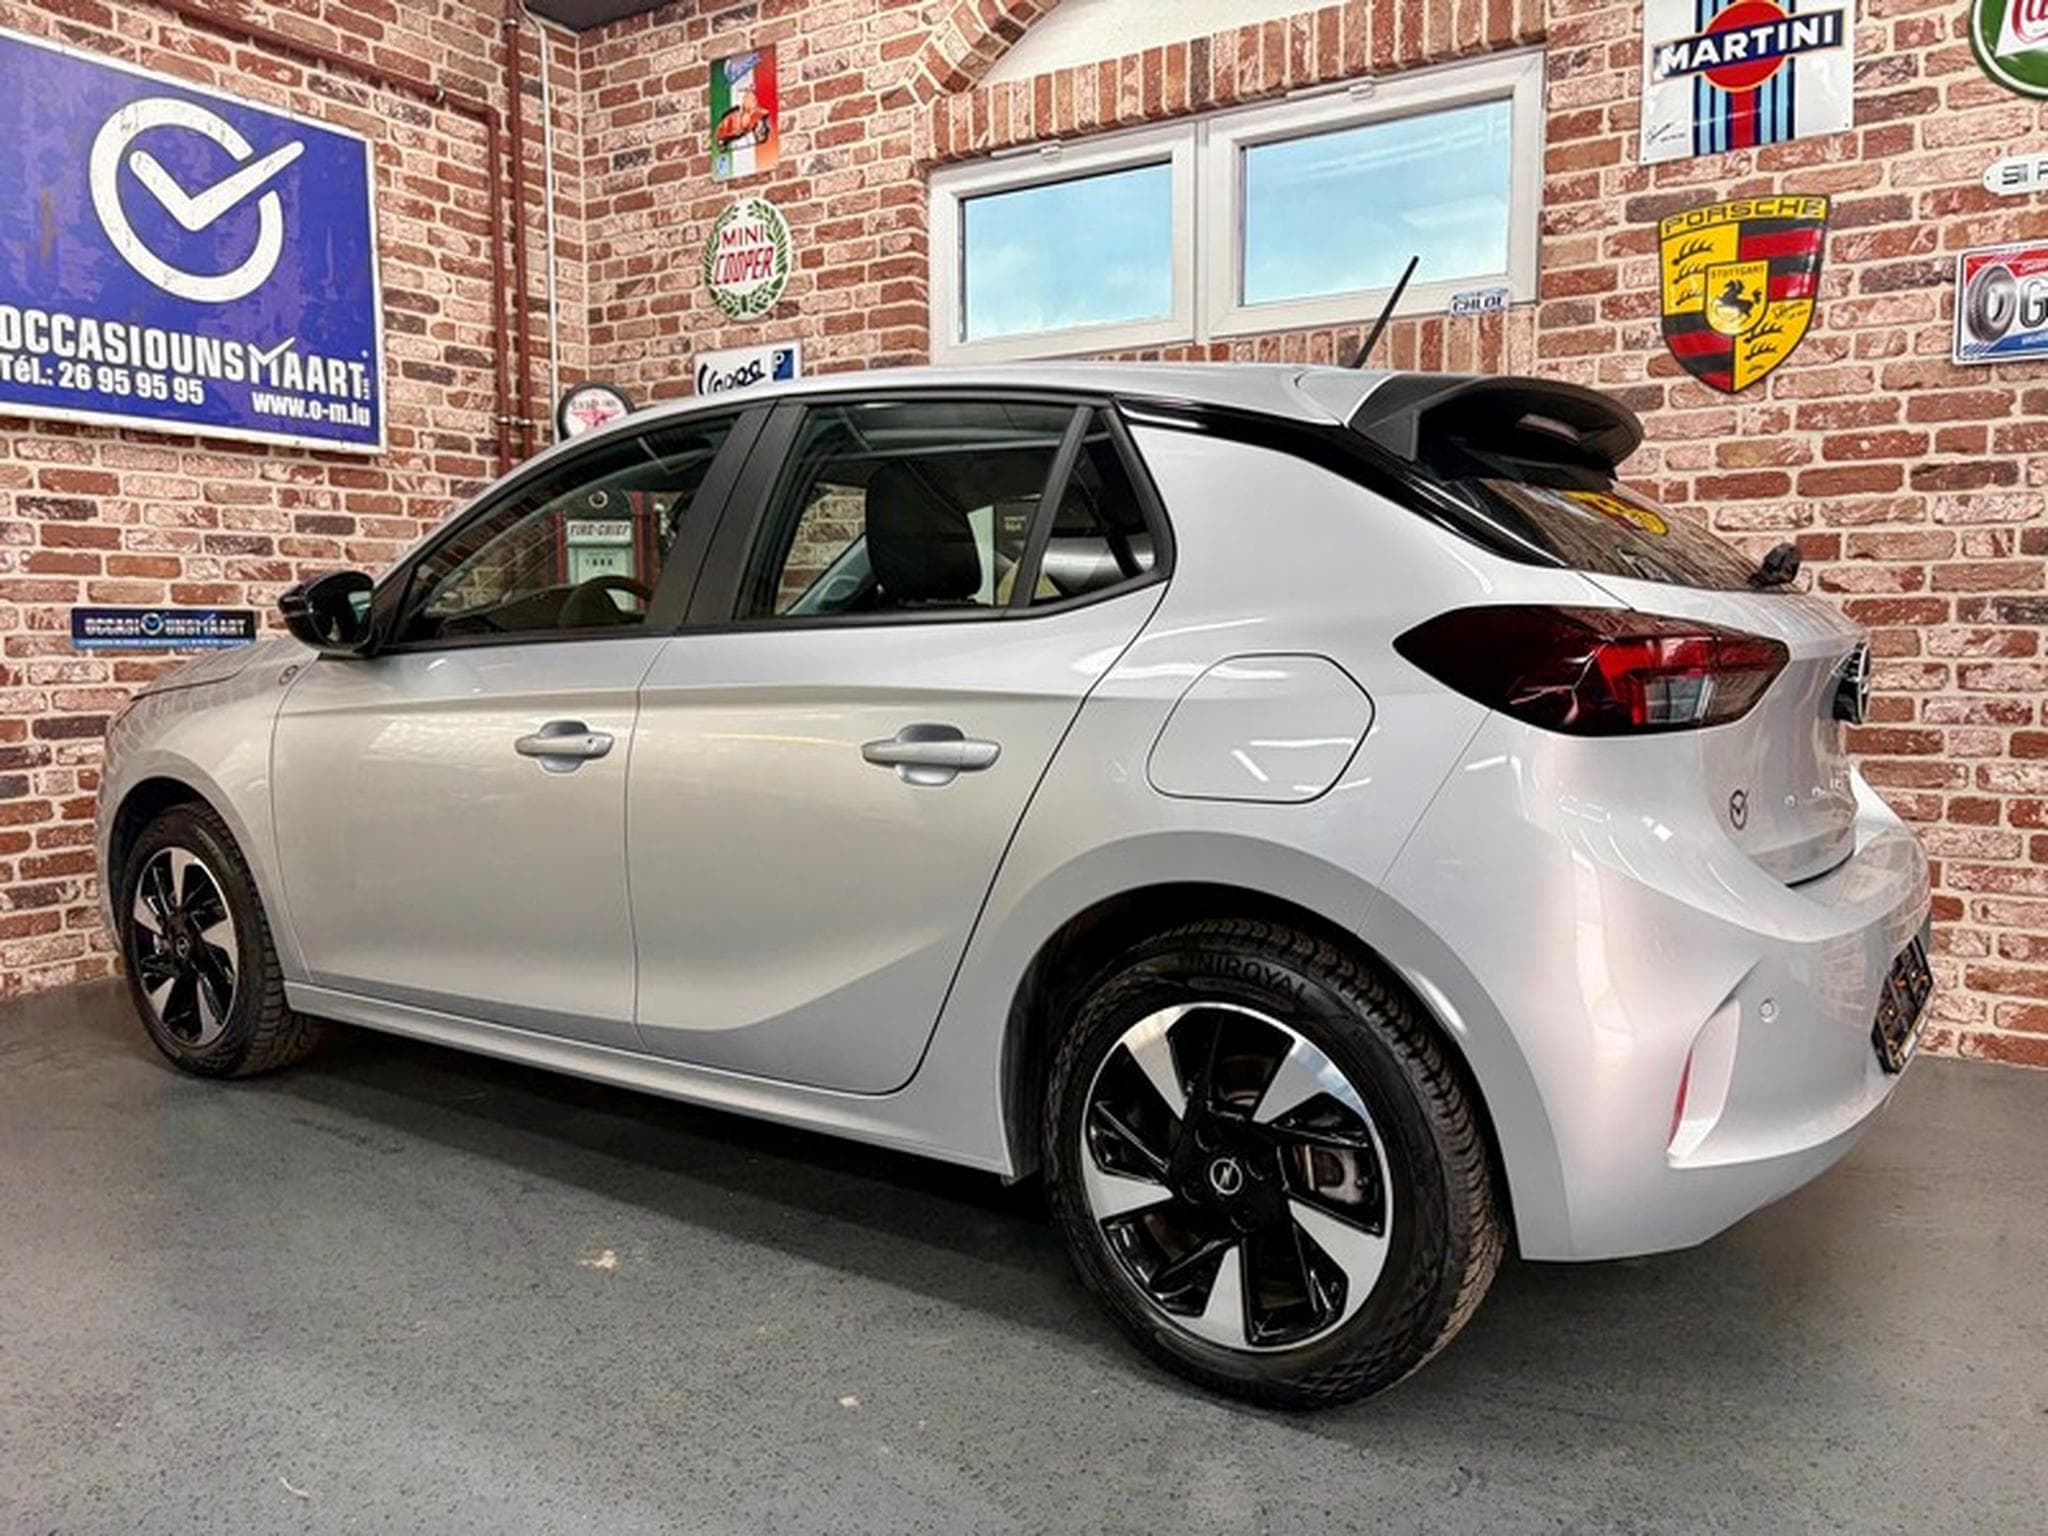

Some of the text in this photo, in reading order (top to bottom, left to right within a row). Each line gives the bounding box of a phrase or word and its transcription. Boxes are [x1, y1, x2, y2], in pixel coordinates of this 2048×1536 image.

[1659, 15, 1834, 74] MARTINI
[721, 224, 766, 246] MINI
[1665, 200, 1823, 233] PORSCHE
[713, 246, 775, 285] COOPER
[0, 305, 366, 400] OCCASIOUNSMAART
[0, 353, 205, 406] Tél.: 26 95 95 95
[252, 391, 371, 427] www.o-m.lu
